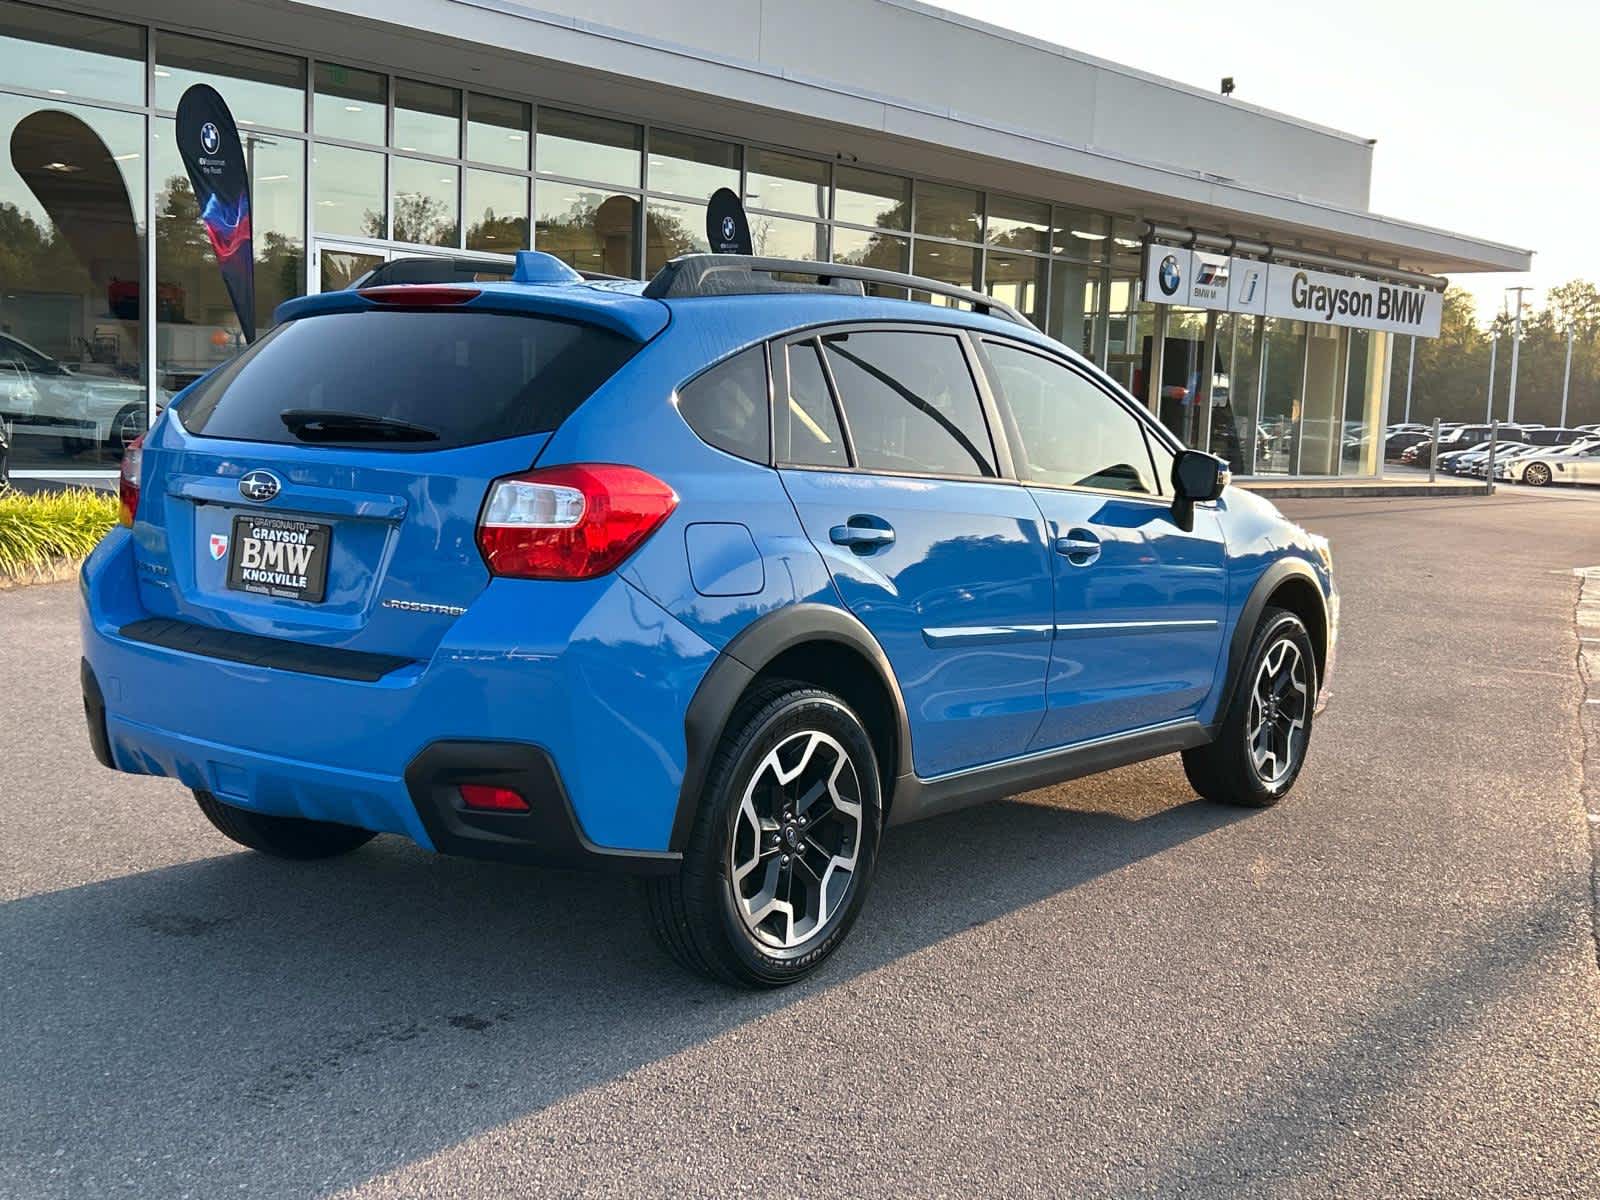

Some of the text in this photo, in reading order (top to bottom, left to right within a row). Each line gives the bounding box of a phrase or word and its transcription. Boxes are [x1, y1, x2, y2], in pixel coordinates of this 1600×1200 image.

[1194, 287, 1209, 298] BMW
[1291, 271, 1426, 325] Grayson BMW
[253, 528, 307, 544] GRAYSON
[240, 537, 315, 575] BMW
[242, 569, 307, 588] KNOXVILLE
[381, 599, 468, 617] CROSSTREK
